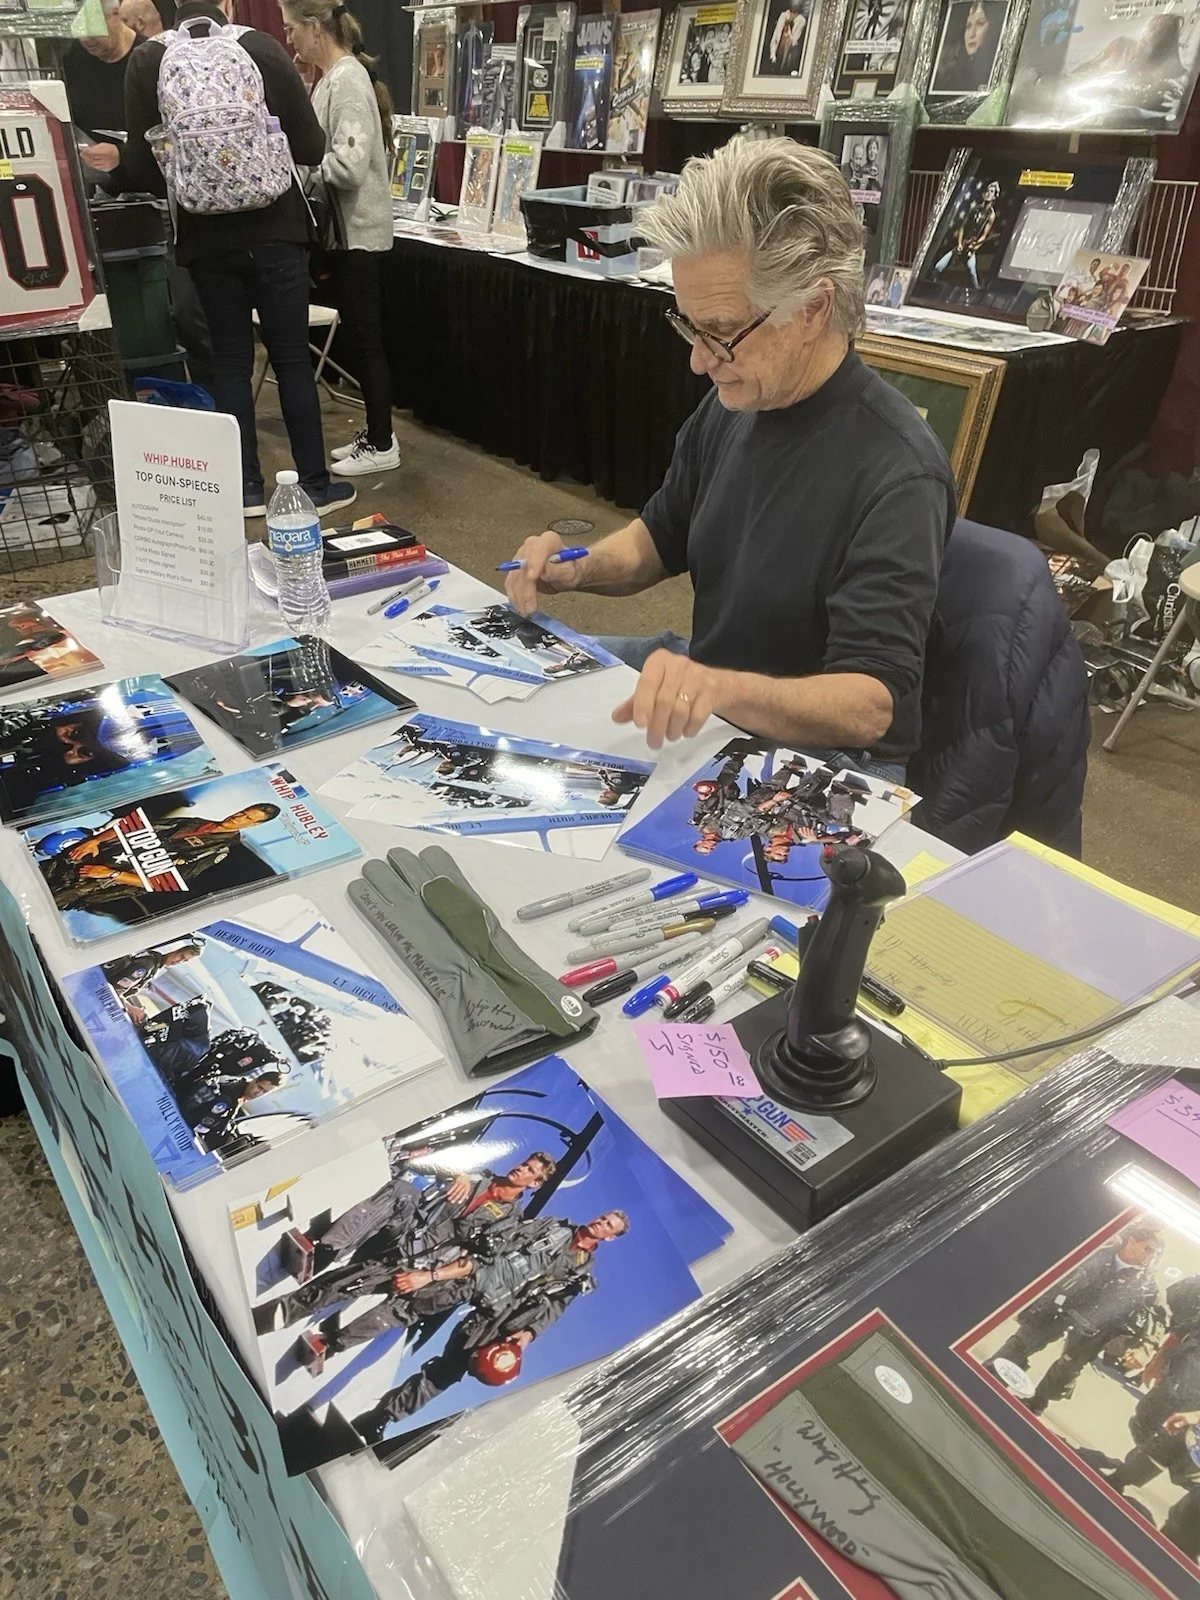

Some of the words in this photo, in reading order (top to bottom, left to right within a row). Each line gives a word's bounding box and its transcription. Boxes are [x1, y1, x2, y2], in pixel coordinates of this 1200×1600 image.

[577, 20, 612, 46] JAWS
[0, 126, 36, 159] LD
[143, 452, 169, 465] WHIP
[171, 456, 209, 472] HUBLEY
[135, 471, 153, 482] TOP
[155, 474, 220, 493] GUN-SPIECES
[159, 493, 181, 505] PRICE
[181, 497, 197, 508] LIST
[349, 556, 376, 568] HAMMETT
[270, 776, 298, 800] WHIP
[289, 803, 330, 840] HUBLEY
[126, 827, 161, 850] TOP
[137, 848, 176, 877] GUN
[215, 929, 248, 946] HENRY
[248, 942, 276, 957] RUTH
[332, 976, 348, 990] LT
[352, 985, 377, 1001] RICK
[717, 1096, 769, 1138] RUSTMASTER
[757, 1100, 792, 1128] GUN
